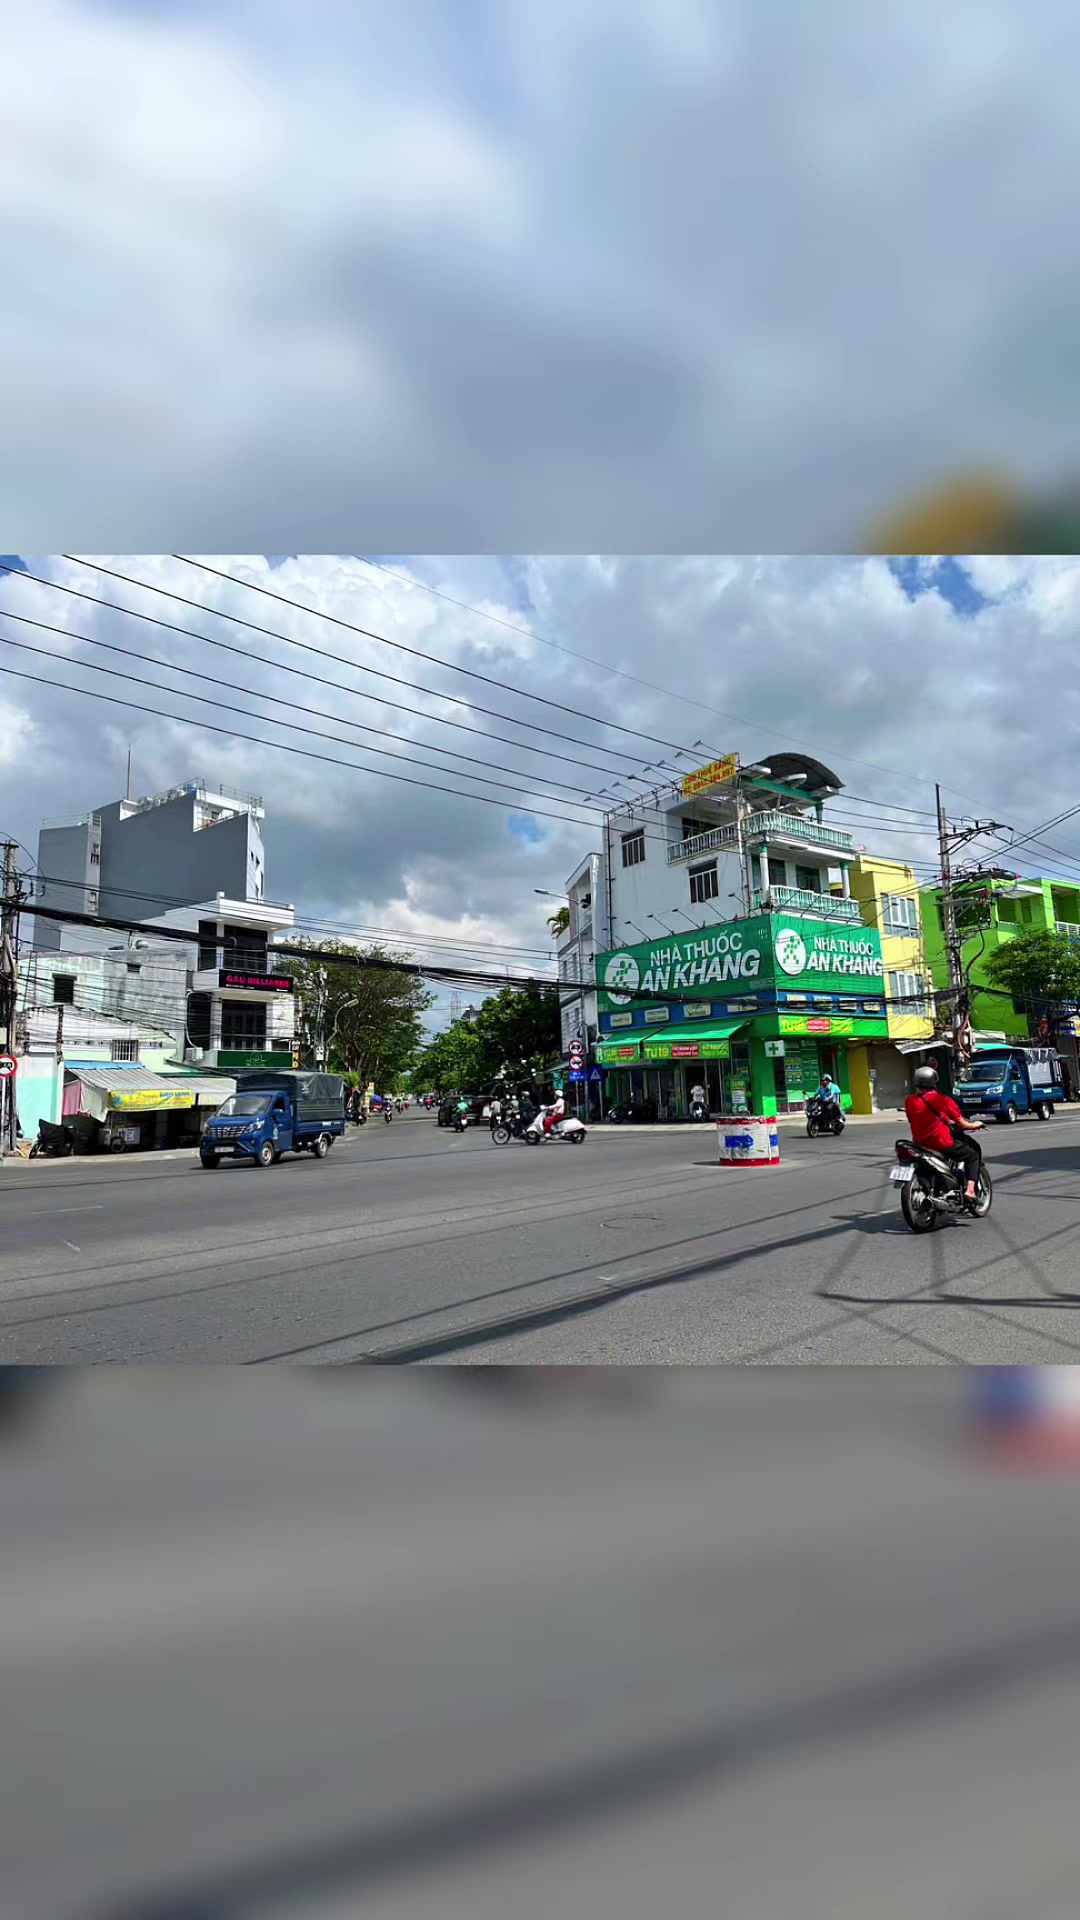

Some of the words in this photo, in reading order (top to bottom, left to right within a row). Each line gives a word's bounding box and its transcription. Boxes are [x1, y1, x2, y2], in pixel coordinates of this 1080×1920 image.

[650, 944, 682, 967] NHÀ
[684, 929, 742, 960] THUỐC
[814, 935, 837, 952] NHÀ
[837, 937, 874, 955] THUỐC
[640, 964, 671, 991] AN
[673, 948, 761, 988] KHANG
[806, 951, 831, 972] AN
[832, 953, 883, 977] KHANG
